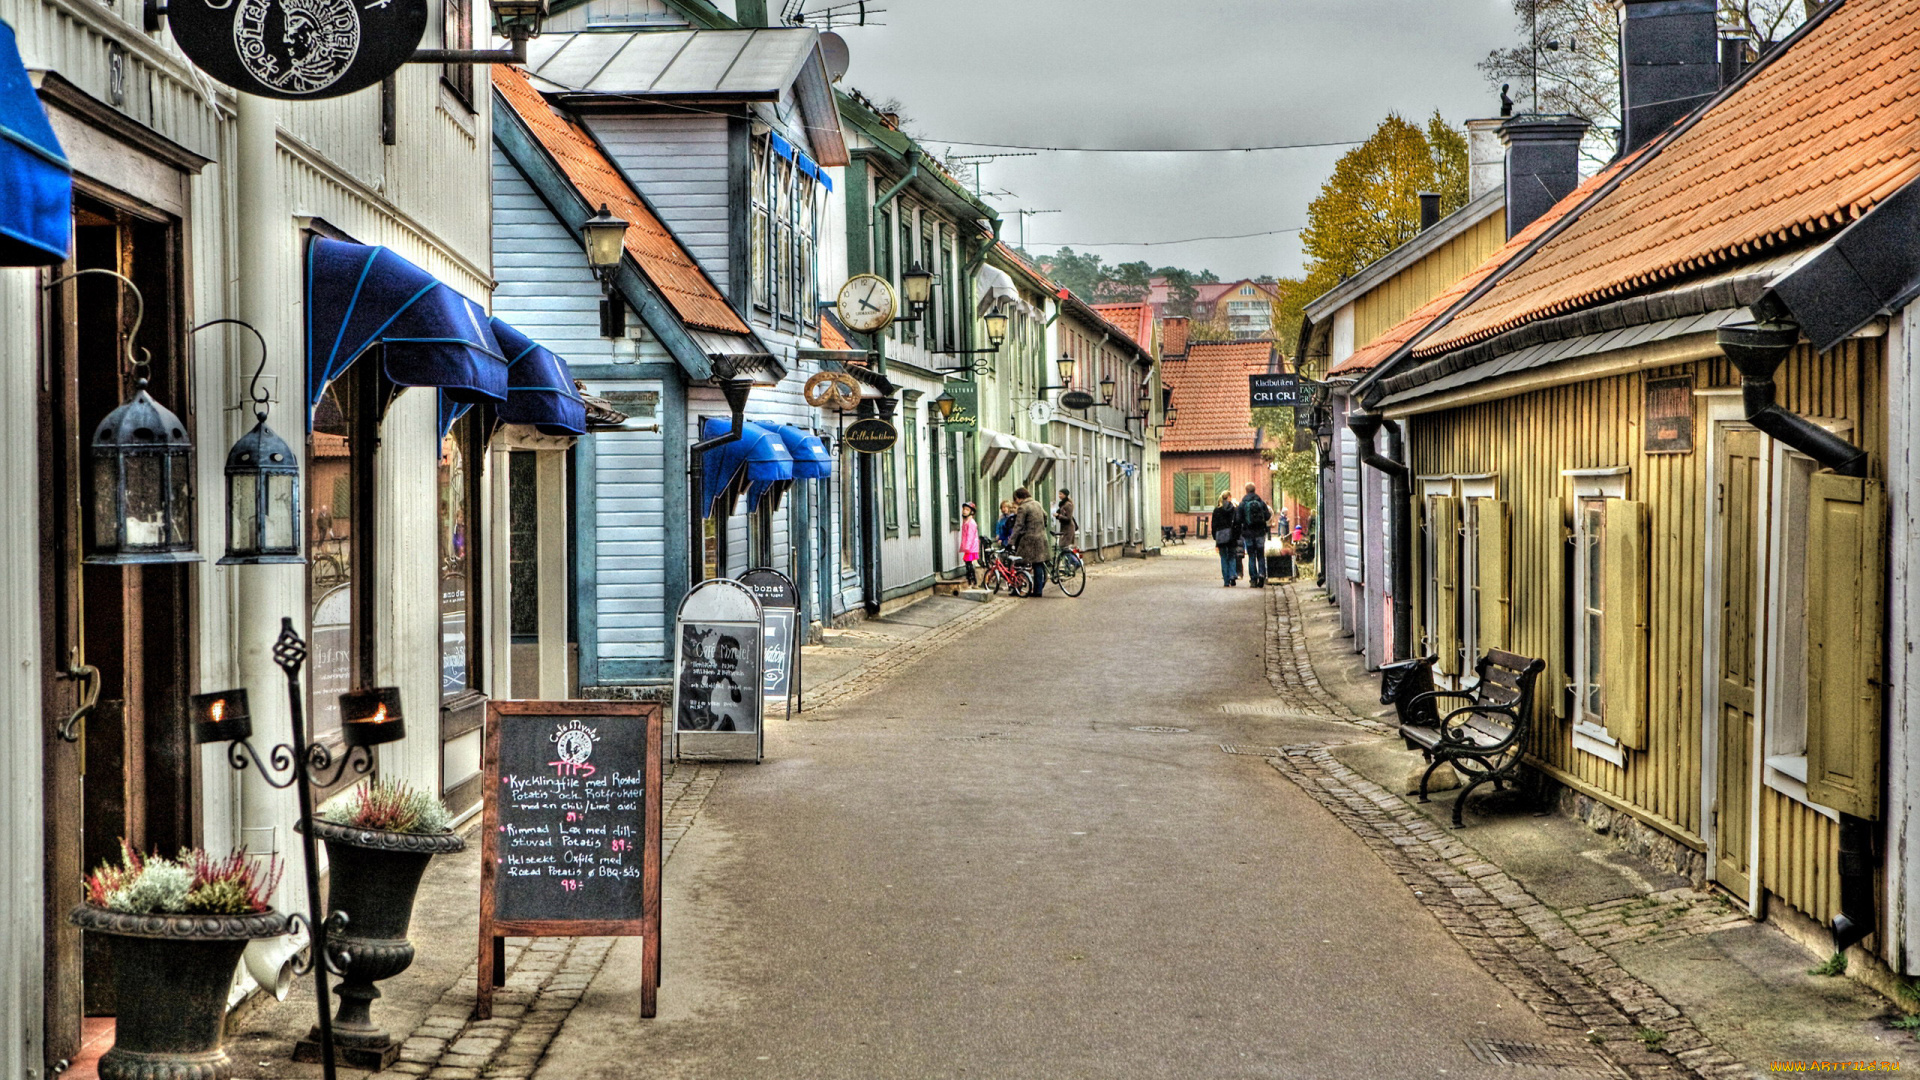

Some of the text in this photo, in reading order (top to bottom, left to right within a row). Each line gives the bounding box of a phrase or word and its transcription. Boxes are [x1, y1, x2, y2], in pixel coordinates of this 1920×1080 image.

[1253, 391, 1296, 401] CRI CRI
[753, 584, 784, 593] bonat
[569, 719, 601, 742] Myntet
[586, 777, 607, 787] med
[586, 825, 606, 835] med
[562, 836, 601, 848] Potatis
[600, 854, 621, 864] med
